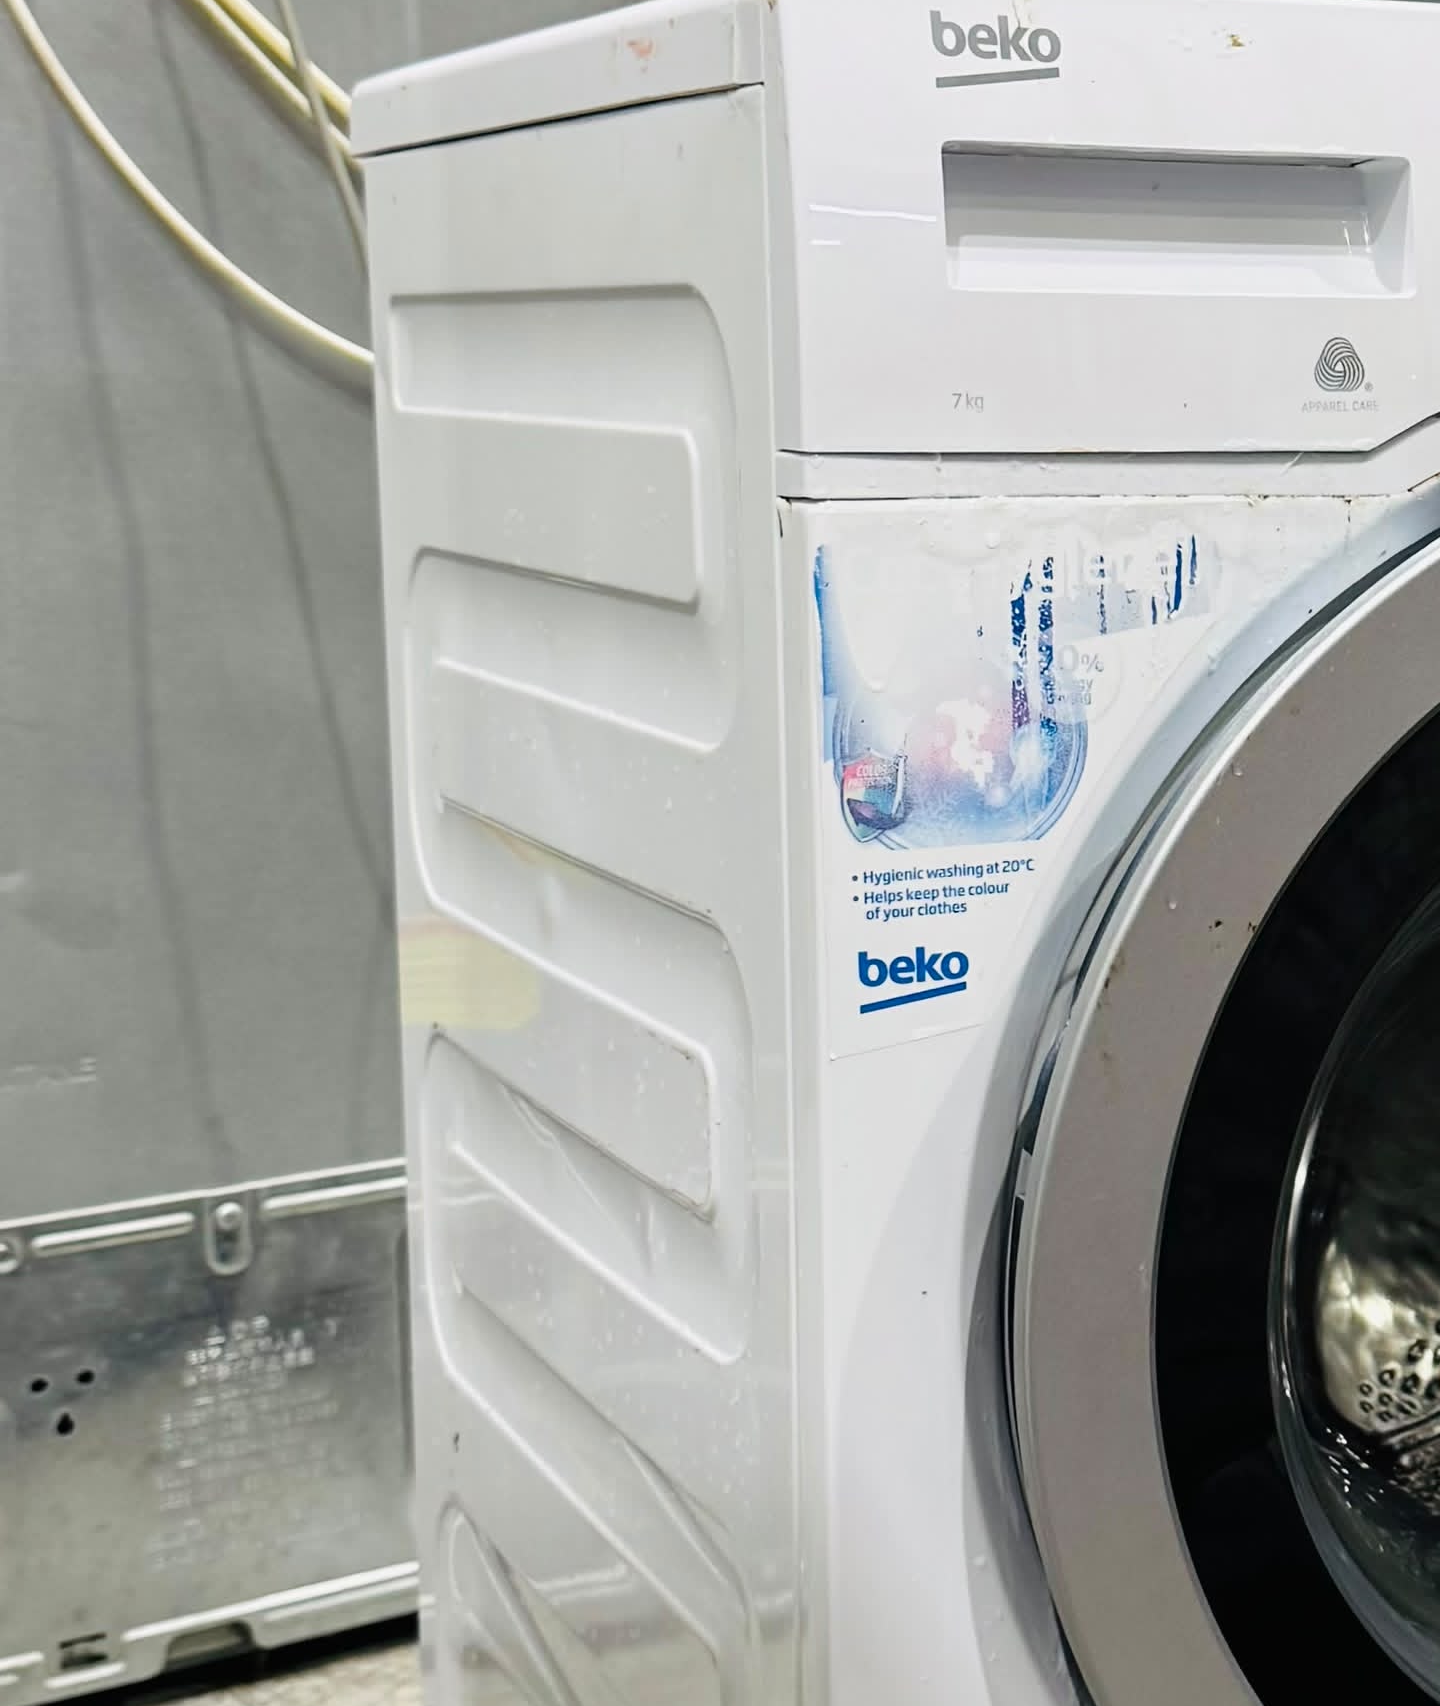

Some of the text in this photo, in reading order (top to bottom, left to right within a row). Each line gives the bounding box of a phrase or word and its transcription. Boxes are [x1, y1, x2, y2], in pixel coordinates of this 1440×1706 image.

[929, 10, 1061, 62] beko
[951, 392, 985, 414] 7 kg
[863, 858, 1035, 886] Hygienic washing at 20°C
[863, 882, 1011, 906] Helps keep the colour
[866, 901, 968, 923] of your clothes
[858, 946, 969, 988] beko
